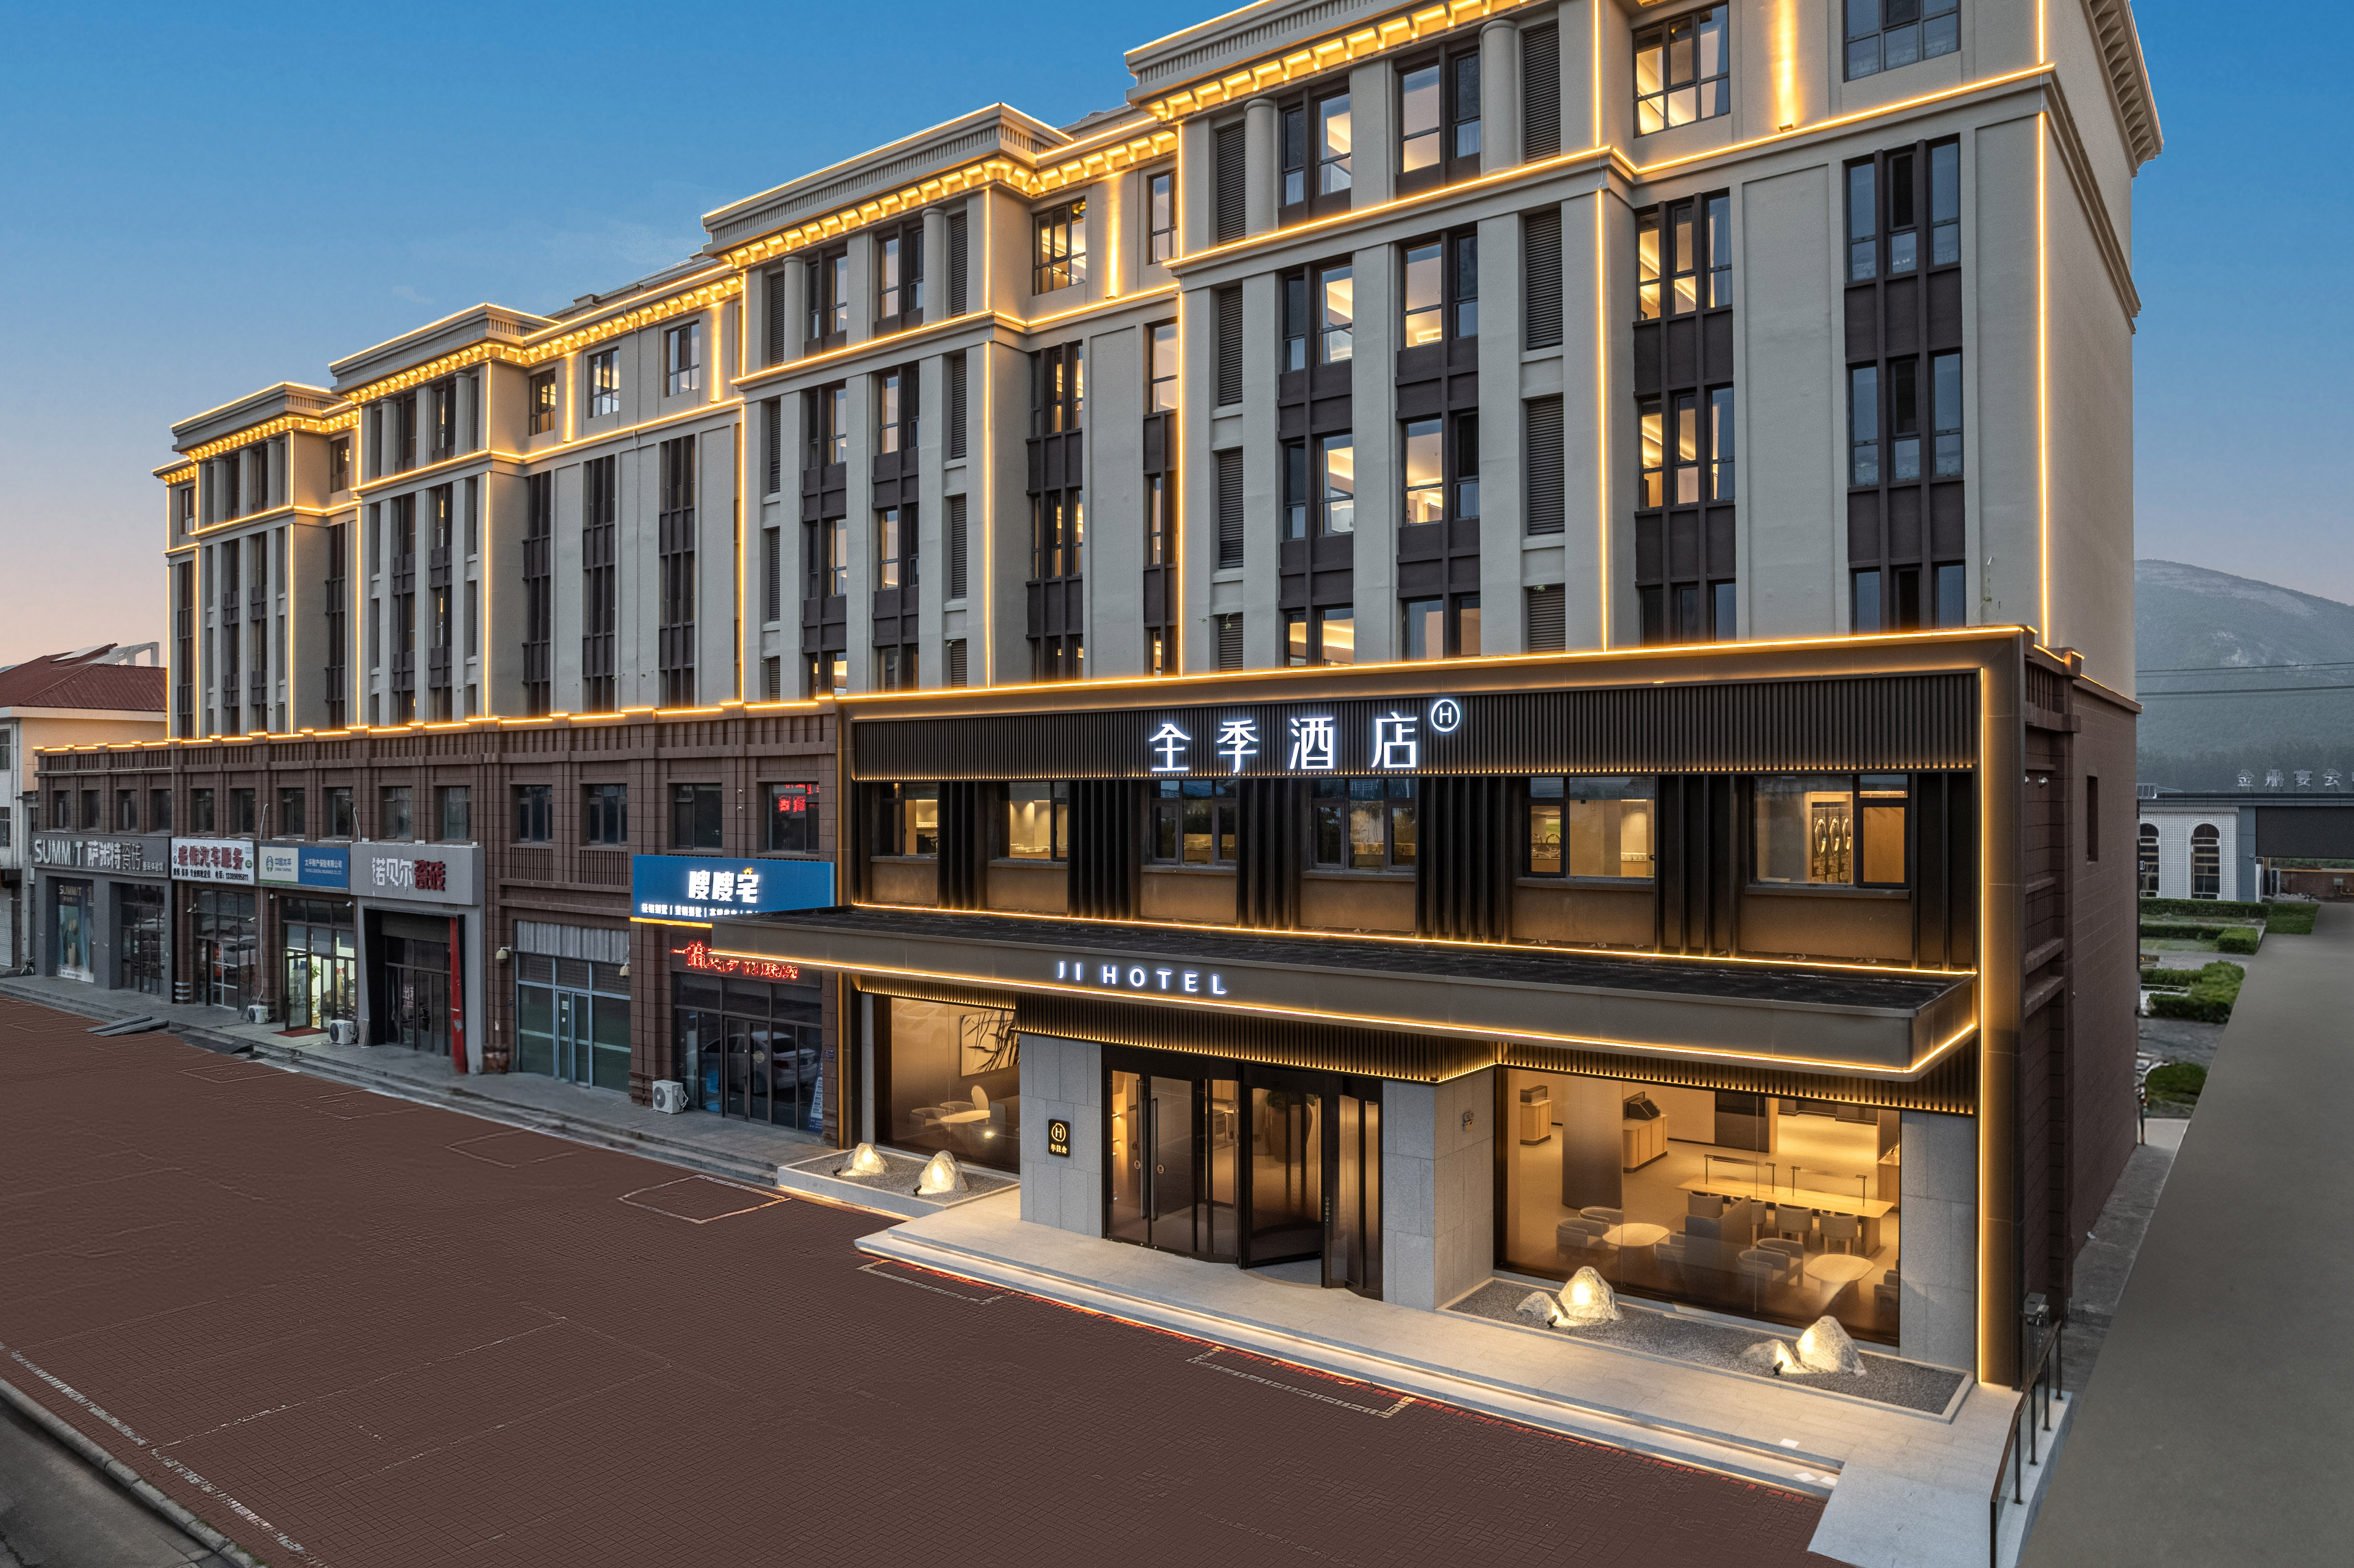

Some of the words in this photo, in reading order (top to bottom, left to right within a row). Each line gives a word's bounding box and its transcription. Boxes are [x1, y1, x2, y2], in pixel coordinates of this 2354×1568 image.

[1149, 711, 1418, 773] 全季酒店
[2237, 768, 2354, 787] 金鼎宴会
[34, 839, 83, 866] SUMMIT
[87, 840, 141, 870] 萨米特瓷砖
[274, 858, 292, 866] 中国太平
[305, 859, 342, 868] 太平财产保险有限公司
[372, 857, 446, 891] 诺贝尔瓷砖
[1058, 961, 1081, 981] JI
[1102, 965, 1226, 995] HOTEL
[1050, 1143, 1067, 1154] 华住会
